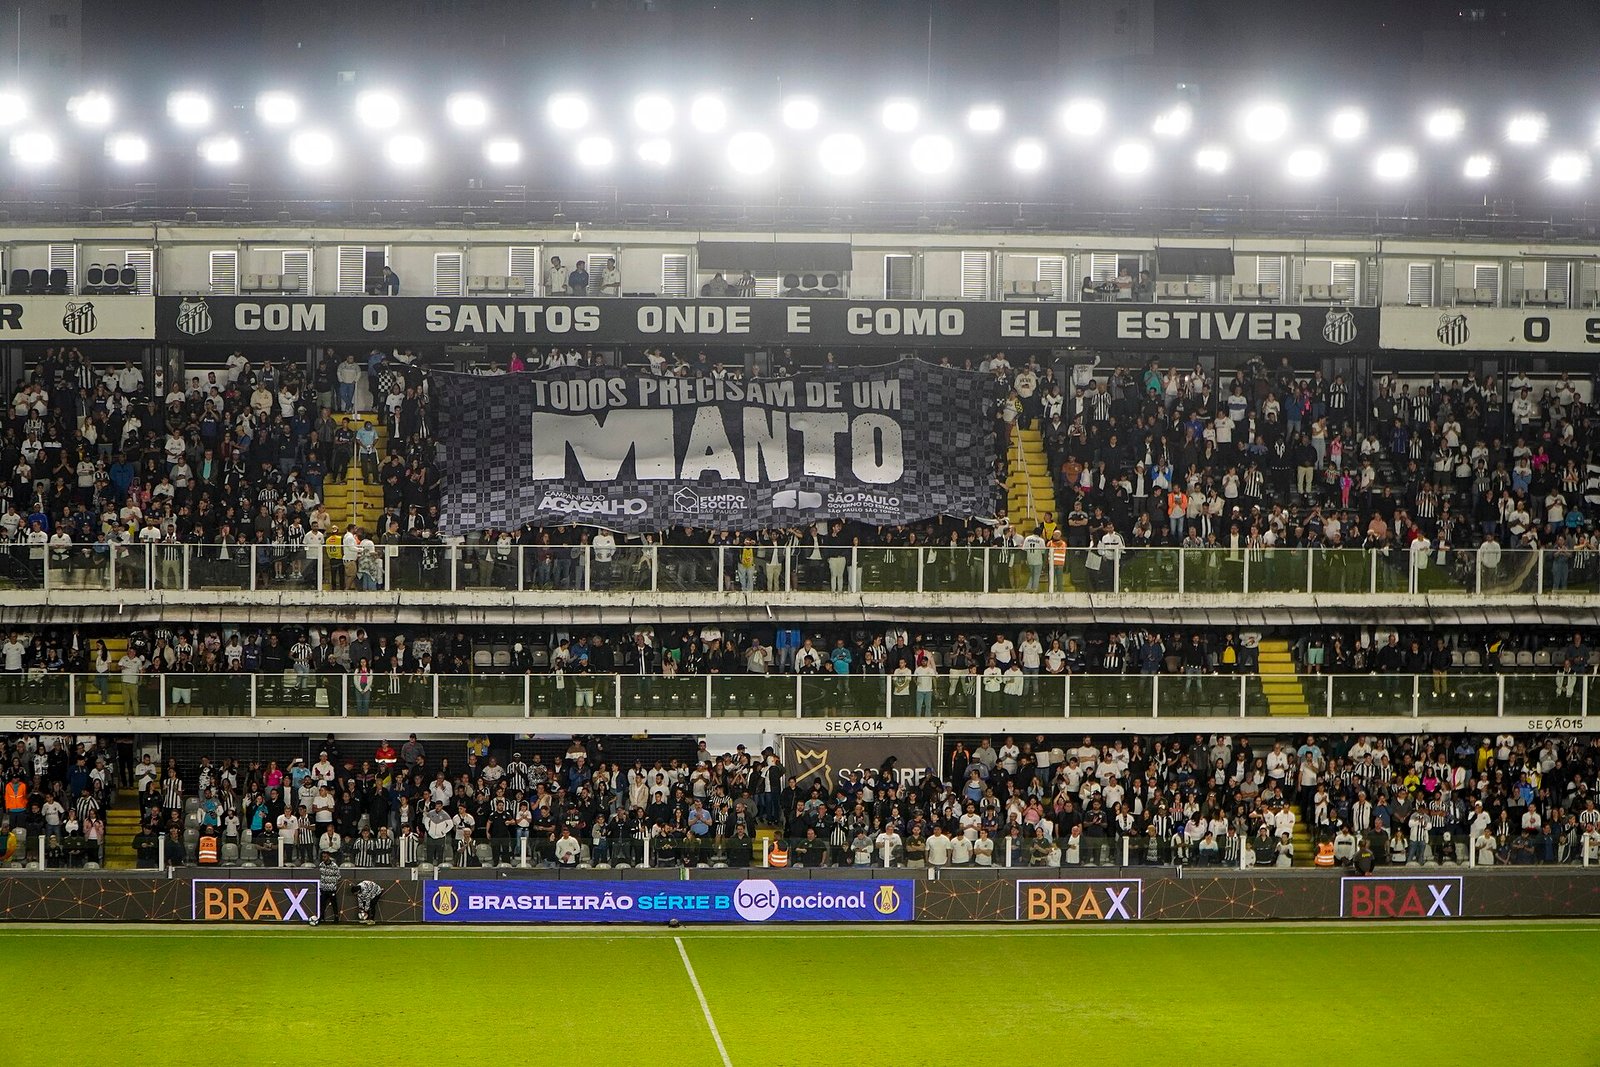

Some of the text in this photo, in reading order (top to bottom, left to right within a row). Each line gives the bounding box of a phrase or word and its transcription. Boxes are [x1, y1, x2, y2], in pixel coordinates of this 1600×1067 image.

[234, 303, 1302, 341] COM O SANTOS ONDE E COMO ELE ESTIVER
[1523, 317, 1550, 343] O
[531, 377, 901, 412] TODOS PRECISAM DE UM
[531, 405, 904, 485] MANTO
[537, 496, 648, 516] AGASALHO
[544, 490, 606, 502] CAMPANHA DO
[700, 494, 748, 510] FUNDO SOCIAL
[827, 491, 900, 507] SÃO PAULO
[827, 501, 862, 509] GOVERNO
[874, 503, 900, 512] ESTADO
[204, 887, 309, 921] BRAX
[468, 891, 731, 910] BRASILEIRÃO SÉRIE B
[1028, 887, 1130, 920] BRAX
[1351, 884, 1452, 917] BRAX
